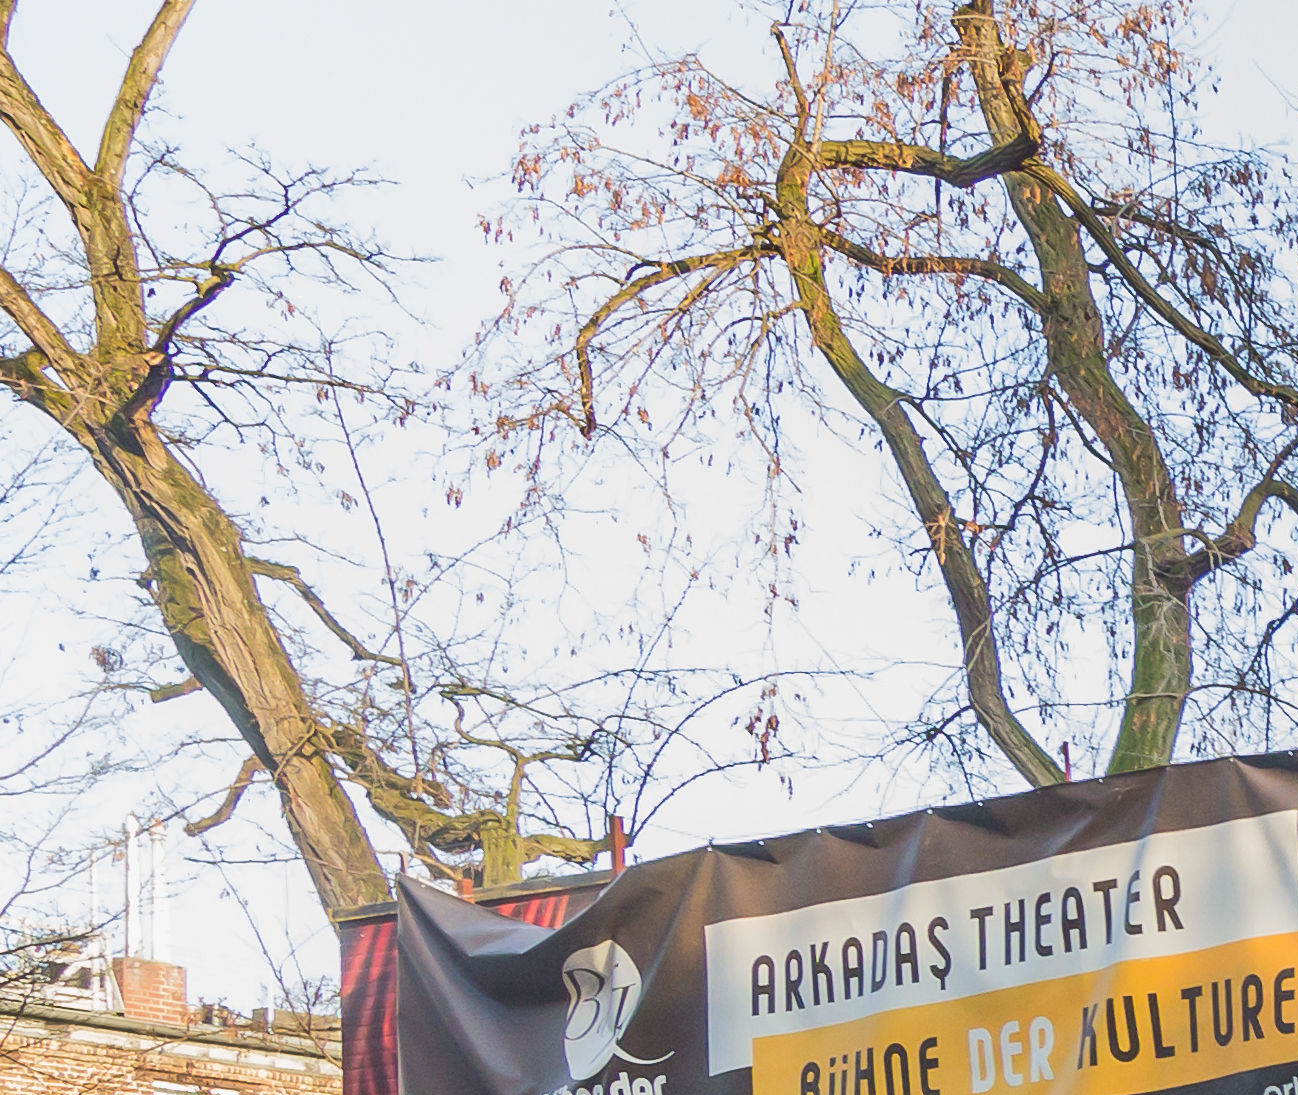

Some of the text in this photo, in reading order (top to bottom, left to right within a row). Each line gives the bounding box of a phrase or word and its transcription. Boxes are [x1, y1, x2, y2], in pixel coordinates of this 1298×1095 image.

[751, 916, 952, 1017] ARKADAŞ
[969, 865, 1184, 972] THEATER
[967, 1015, 1056, 1095] DER
